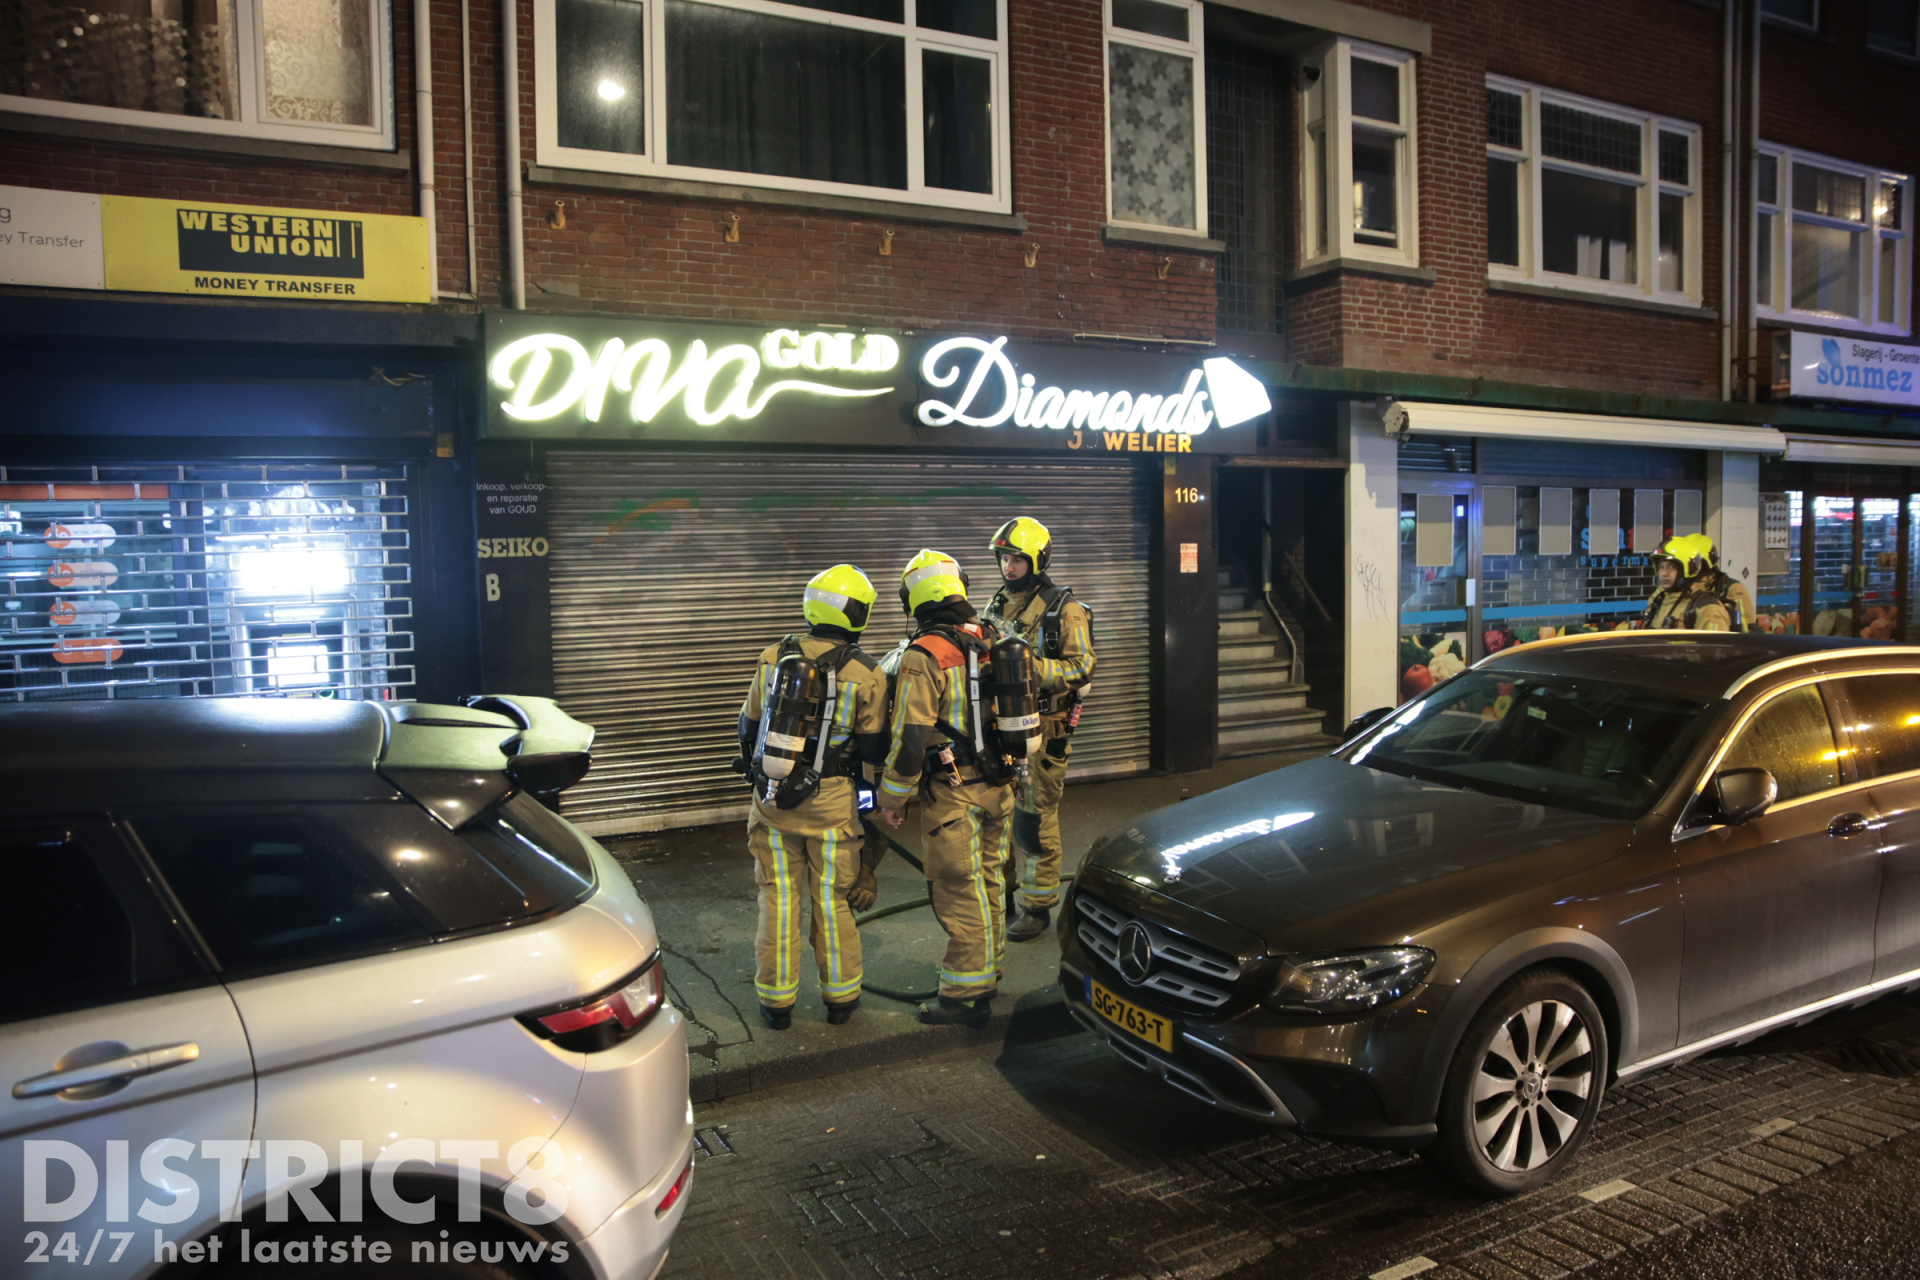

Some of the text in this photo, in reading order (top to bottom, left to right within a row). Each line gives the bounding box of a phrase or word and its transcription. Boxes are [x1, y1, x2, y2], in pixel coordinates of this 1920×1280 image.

[179, 211, 333, 239] WESTERN
[17, 231, 85, 248] Transfer
[231, 234, 334, 258] UNION
[195, 277, 356, 295] MONEY TRANSFER
[763, 329, 899, 372] GOLD
[1852, 344, 1882, 363] Slagerij
[916, 336, 1214, 435] Diamonds
[1067, 430, 1192, 453] JWELIER
[476, 482, 508, 492] Inkoop,
[1175, 487, 1199, 504] 116
[500, 494, 538, 504] reparatie
[508, 505, 537, 514] GOUD
[477, 536, 549, 558] SEIKO
[1580, 555, 1649, 569] superma
[485, 573, 501, 602] B
[1094, 987, 1164, 1043] SG-763-T
